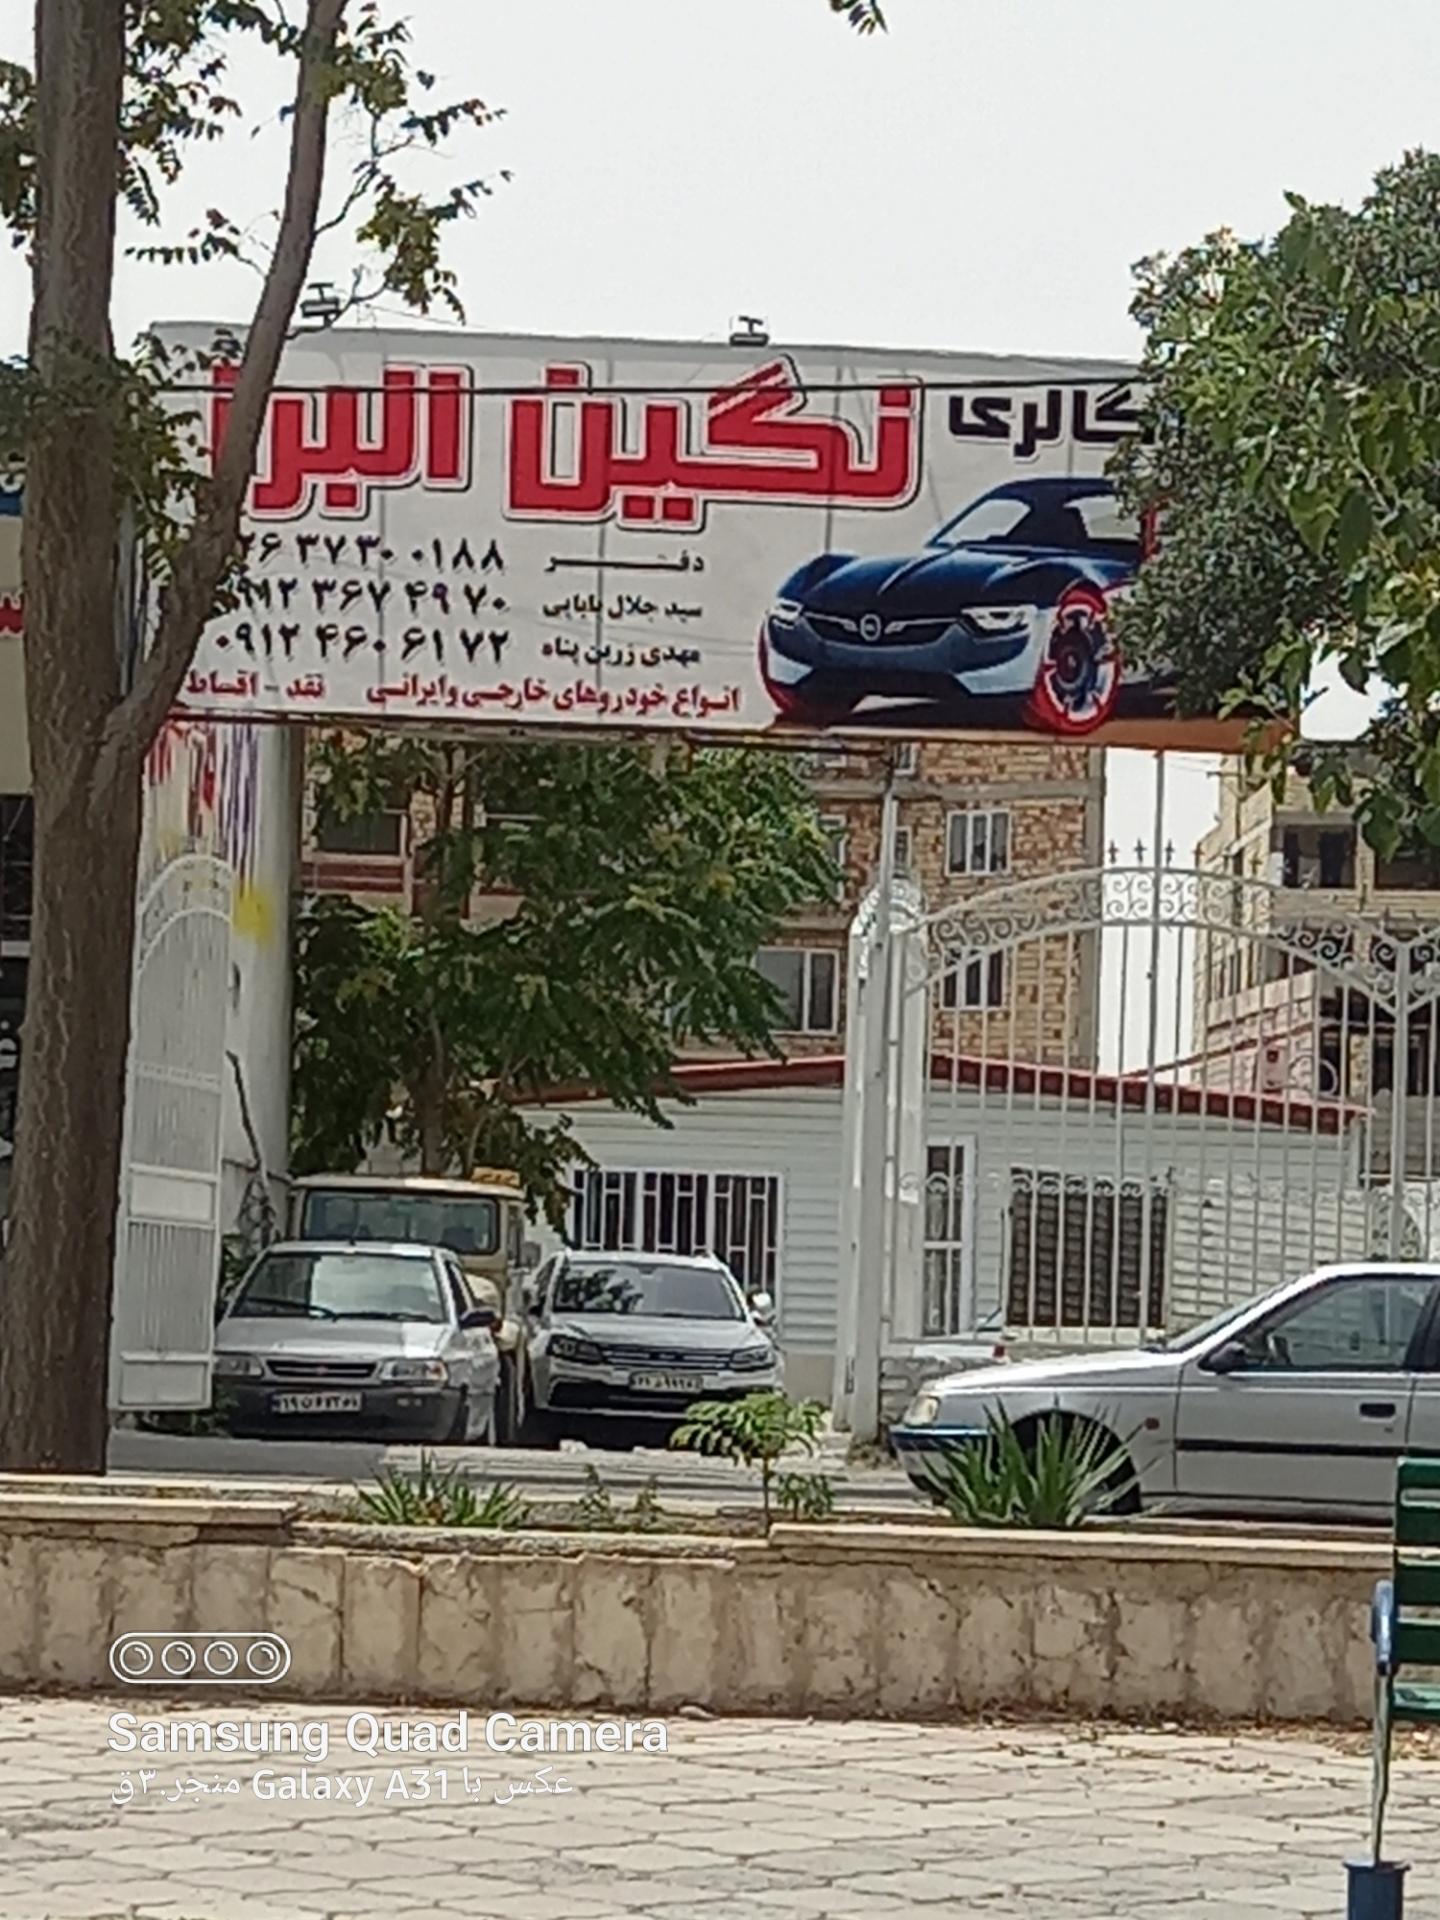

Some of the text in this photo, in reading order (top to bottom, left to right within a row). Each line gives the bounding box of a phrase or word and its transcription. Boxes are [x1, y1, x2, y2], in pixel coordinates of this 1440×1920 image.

[948, 384, 1157, 457] گالری
[503, 355, 922, 531] نگین
[544, 550, 704, 573] دفتر
[608, 594, 659, 623] جلال
[664, 602, 703, 623] سید
[541, 637, 579, 665] پناه
[640, 645, 701, 668] مهدی
[186, 669, 260, 697] اقساط
[286, 673, 326, 698] نقد
[462, 677, 549, 710] خارجی
[552, 680, 669, 717] خودروهای
[671, 684, 742, 718] انواع
